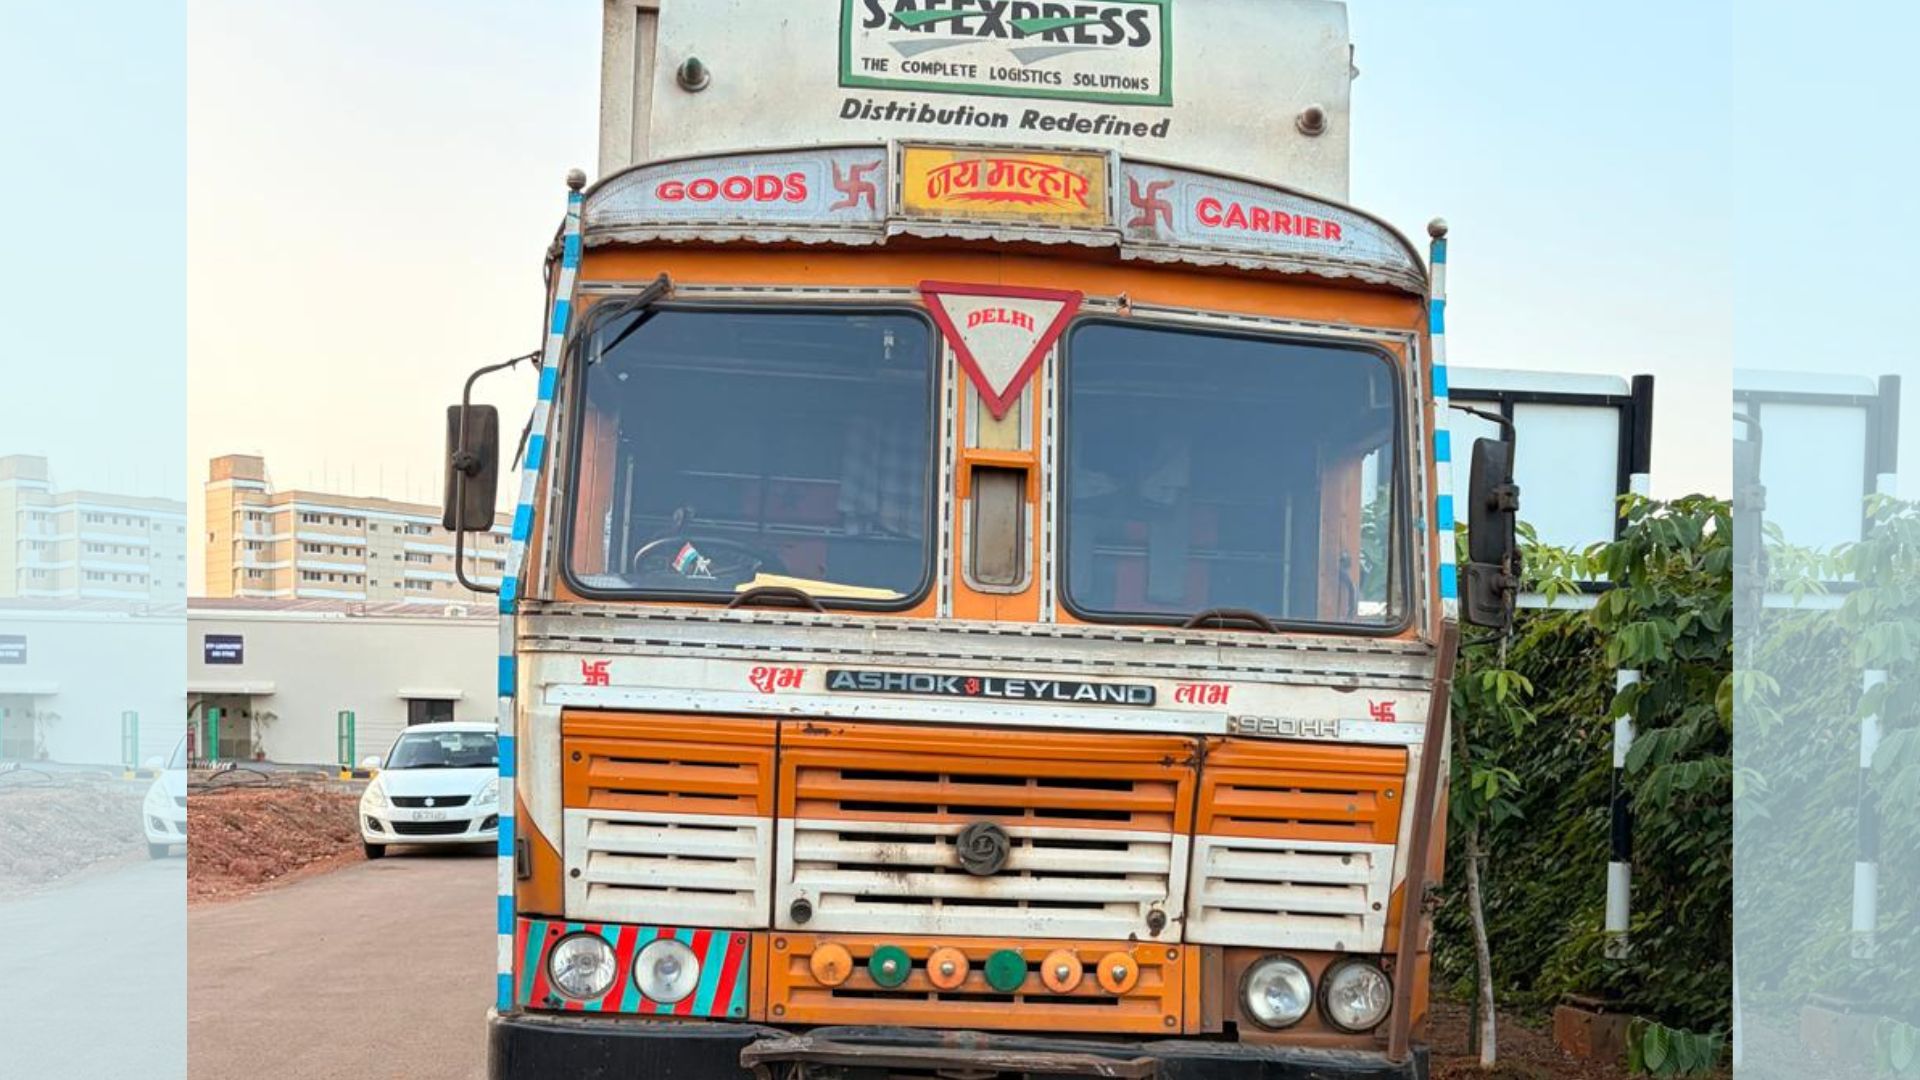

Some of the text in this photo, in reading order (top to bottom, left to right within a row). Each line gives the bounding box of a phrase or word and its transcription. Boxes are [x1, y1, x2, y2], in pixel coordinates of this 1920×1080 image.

[863, 0, 1151, 47] SAFEXPRESS
[861, 58, 1149, 91] THE COMPLETE LOGISTICS SOLUTIONS
[839, 98, 1170, 139] Distribution Redefined
[656, 172, 808, 203] GOODS
[927, 159, 1090, 208] जय मल्हार
[1196, 197, 1342, 241] CARRIER
[967, 308, 1035, 333] DELHI
[749, 666, 807, 694] शुभ
[831, 671, 960, 694] ASHOK
[984, 678, 1152, 704] LEYLAND
[1174, 683, 1232, 705] लाभ
